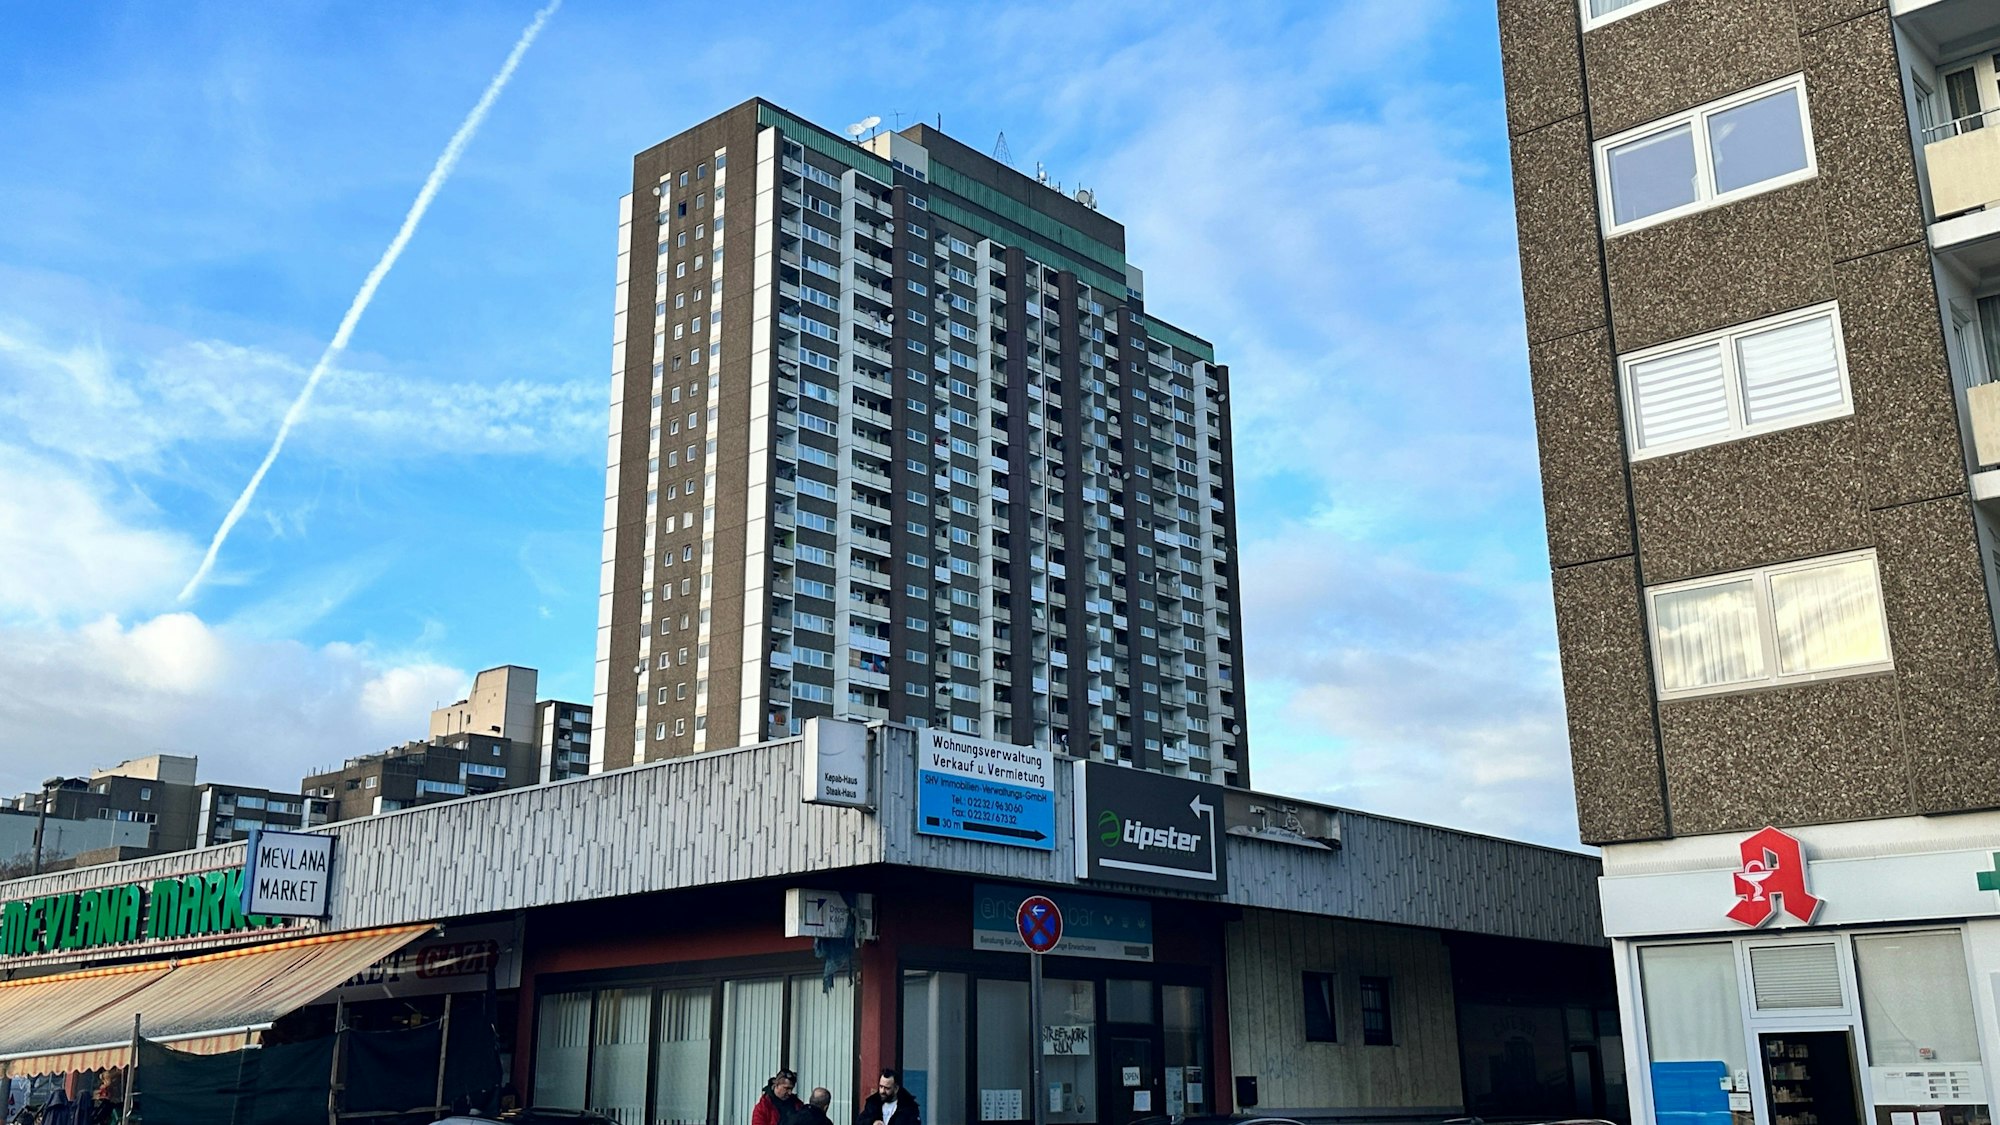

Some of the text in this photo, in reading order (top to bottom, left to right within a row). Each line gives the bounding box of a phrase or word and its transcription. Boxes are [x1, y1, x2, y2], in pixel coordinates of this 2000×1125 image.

[933, 735, 1042, 770] Wohnungsverwaltung
[825, 773, 858, 785] Kepab-Haus
[925, 774, 939, 785] SHV
[933, 753, 1045, 787] Verkauf u. Vermietung
[826, 786, 857, 798] Steak-Haus
[942, 818, 961, 830] 30 m
[1123, 819, 1201, 852] tipster
[260, 846, 326, 873] MEVLANA
[259, 878, 318, 903] MARKET
[1, 869, 284, 955] MEVLANA MARK
[1124, 1072, 1139, 1081] OPEN
